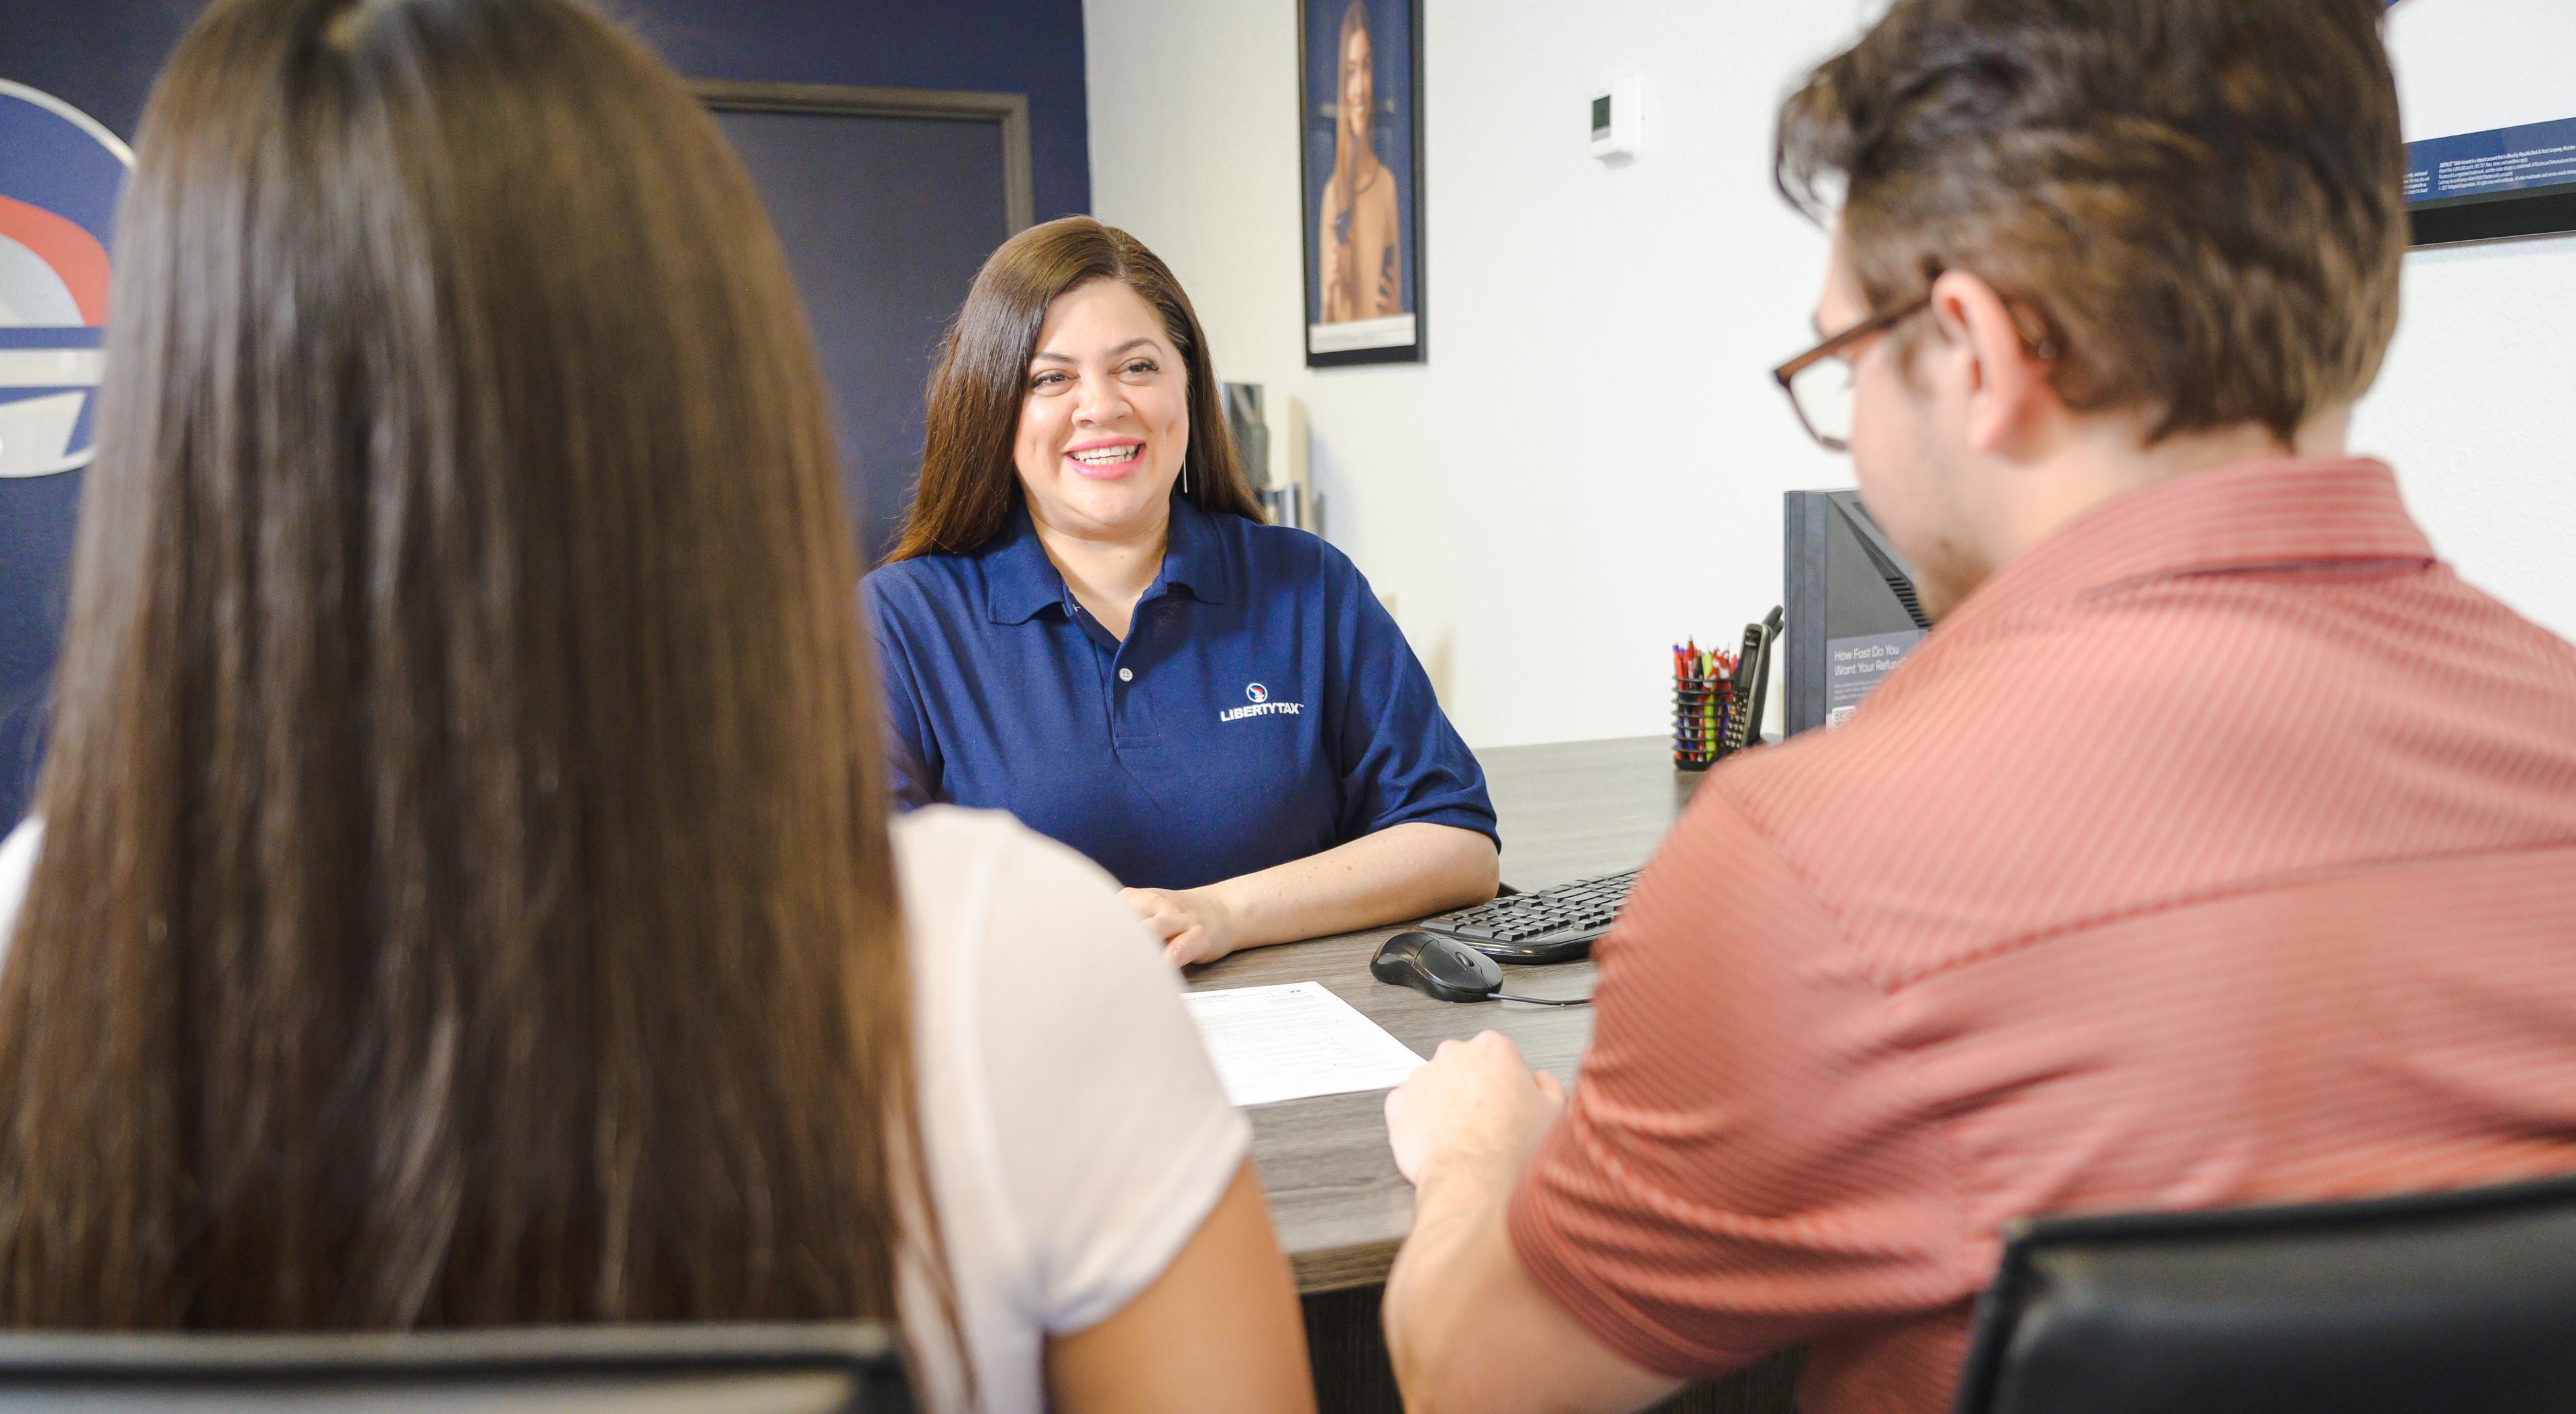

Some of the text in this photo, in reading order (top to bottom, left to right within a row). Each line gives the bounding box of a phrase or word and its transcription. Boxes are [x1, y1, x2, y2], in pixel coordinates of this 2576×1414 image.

[1834, 644, 1899, 661] How Fast Do You
[1834, 664, 1856, 676] Want
[1858, 661, 1874, 673] Your
